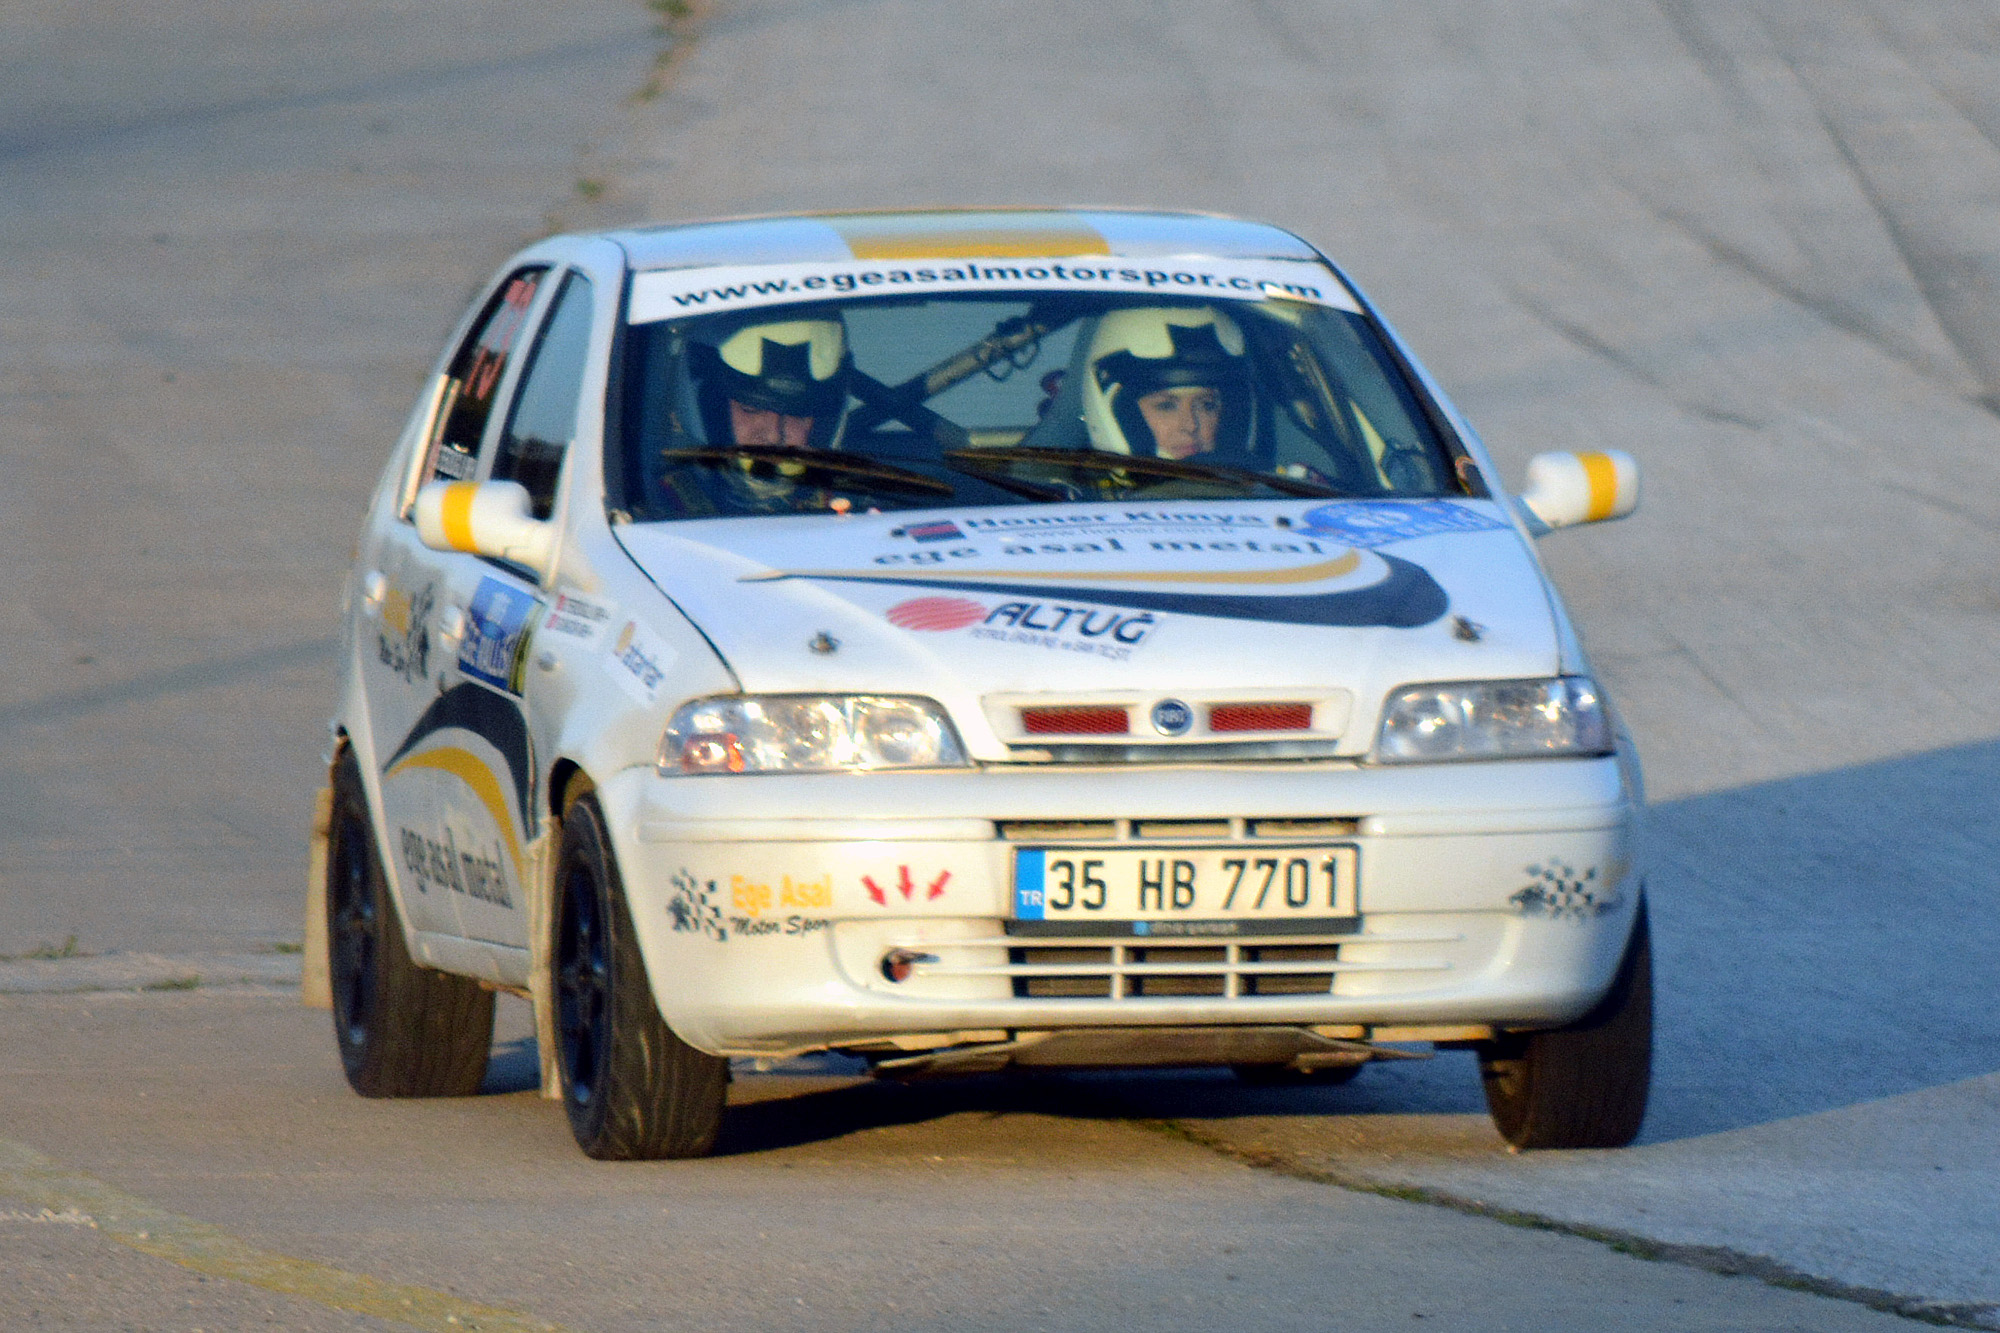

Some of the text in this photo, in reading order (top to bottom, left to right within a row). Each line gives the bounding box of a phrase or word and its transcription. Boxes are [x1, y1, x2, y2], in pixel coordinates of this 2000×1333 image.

[672, 263, 1322, 306] www.egeasalmotorspor.com
[874, 537, 1324, 565] ege asal metal
[731, 874, 833, 917] Ege Asal
[1020, 856, 1338, 911] TR 35 HB 7701
